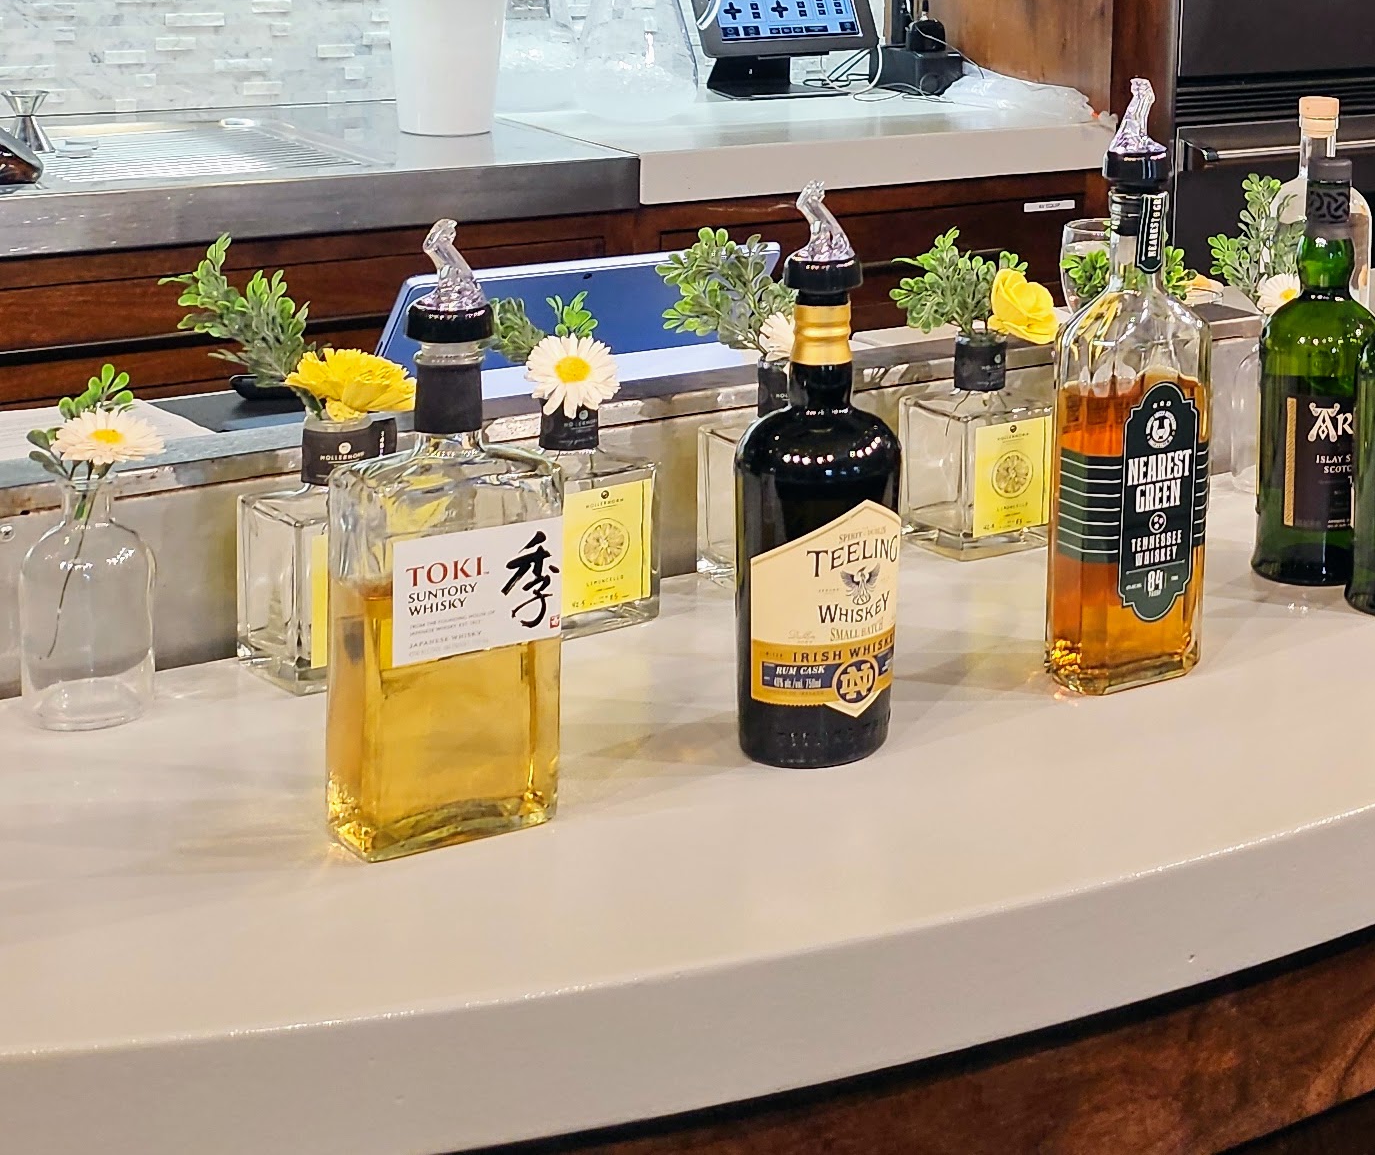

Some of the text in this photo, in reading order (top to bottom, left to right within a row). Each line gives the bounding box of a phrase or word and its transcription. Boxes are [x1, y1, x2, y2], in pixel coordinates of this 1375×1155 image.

[1127, 449, 1192, 486] NEAREST
[1316, 454, 1343, 464] ISLAY
[1324, 465, 1352, 474] SCOTC
[1135, 478, 1181, 513] GREEN
[1131, 530, 1182, 553] TENNESSEE
[806, 534, 898, 578] TEELING
[1135, 545, 1178, 567] WHISKEY
[405, 556, 484, 588] TOKI
[1147, 569, 1164, 592] 84
[408, 582, 478, 604] SUNTORY
[408, 597, 467, 616] WHISKY
[818, 590, 891, 624] WHISKEY
[409, 638, 448, 649] JAPANESE
[451, 631, 483, 641] WHISKY
[830, 627, 860, 642] SMALL
[793, 633, 894, 663] IRISH WHISKE
[776, 665, 826, 675] RUM CASK
